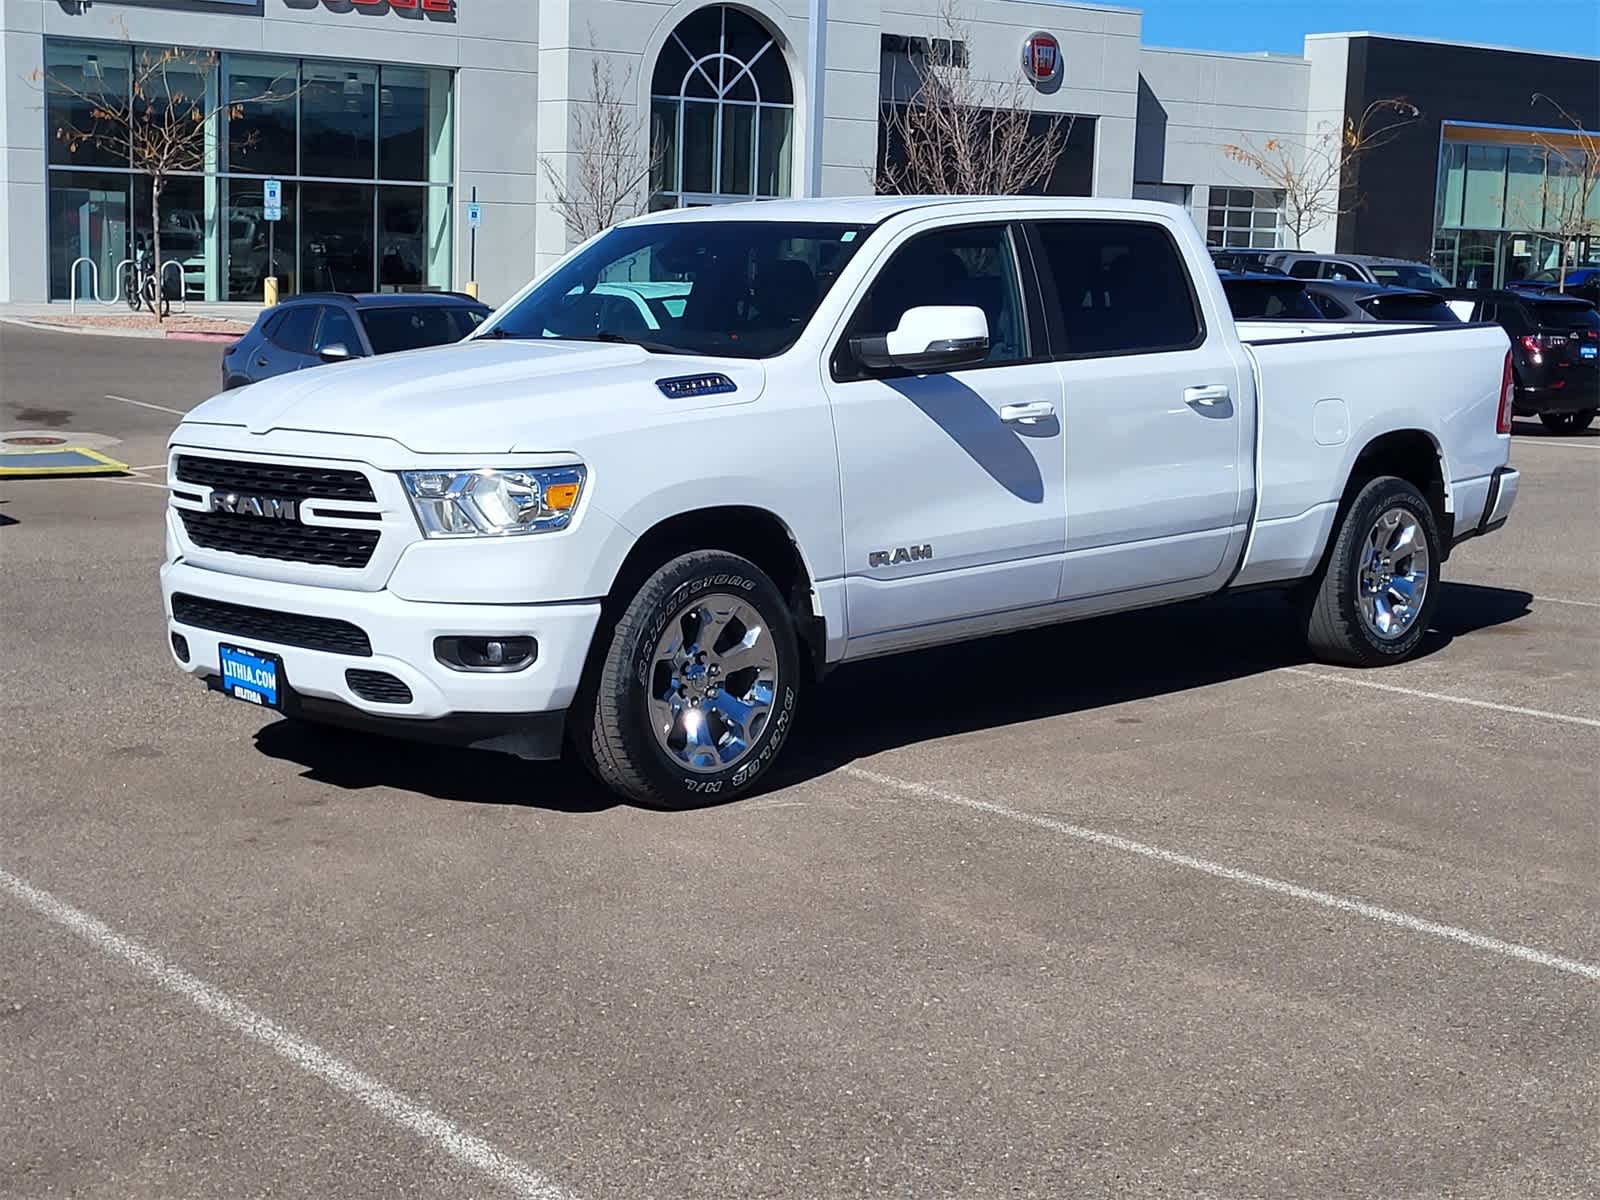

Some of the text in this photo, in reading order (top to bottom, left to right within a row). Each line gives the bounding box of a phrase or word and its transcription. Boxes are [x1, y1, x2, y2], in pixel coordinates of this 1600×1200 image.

[210, 492, 296, 520] RAM
[869, 544, 933, 568] RAM
[639, 573, 757, 687] BRIDGESTONE
[222, 657, 277, 692] LITHIA.COM
[684, 685, 795, 793] DUELER H/L
